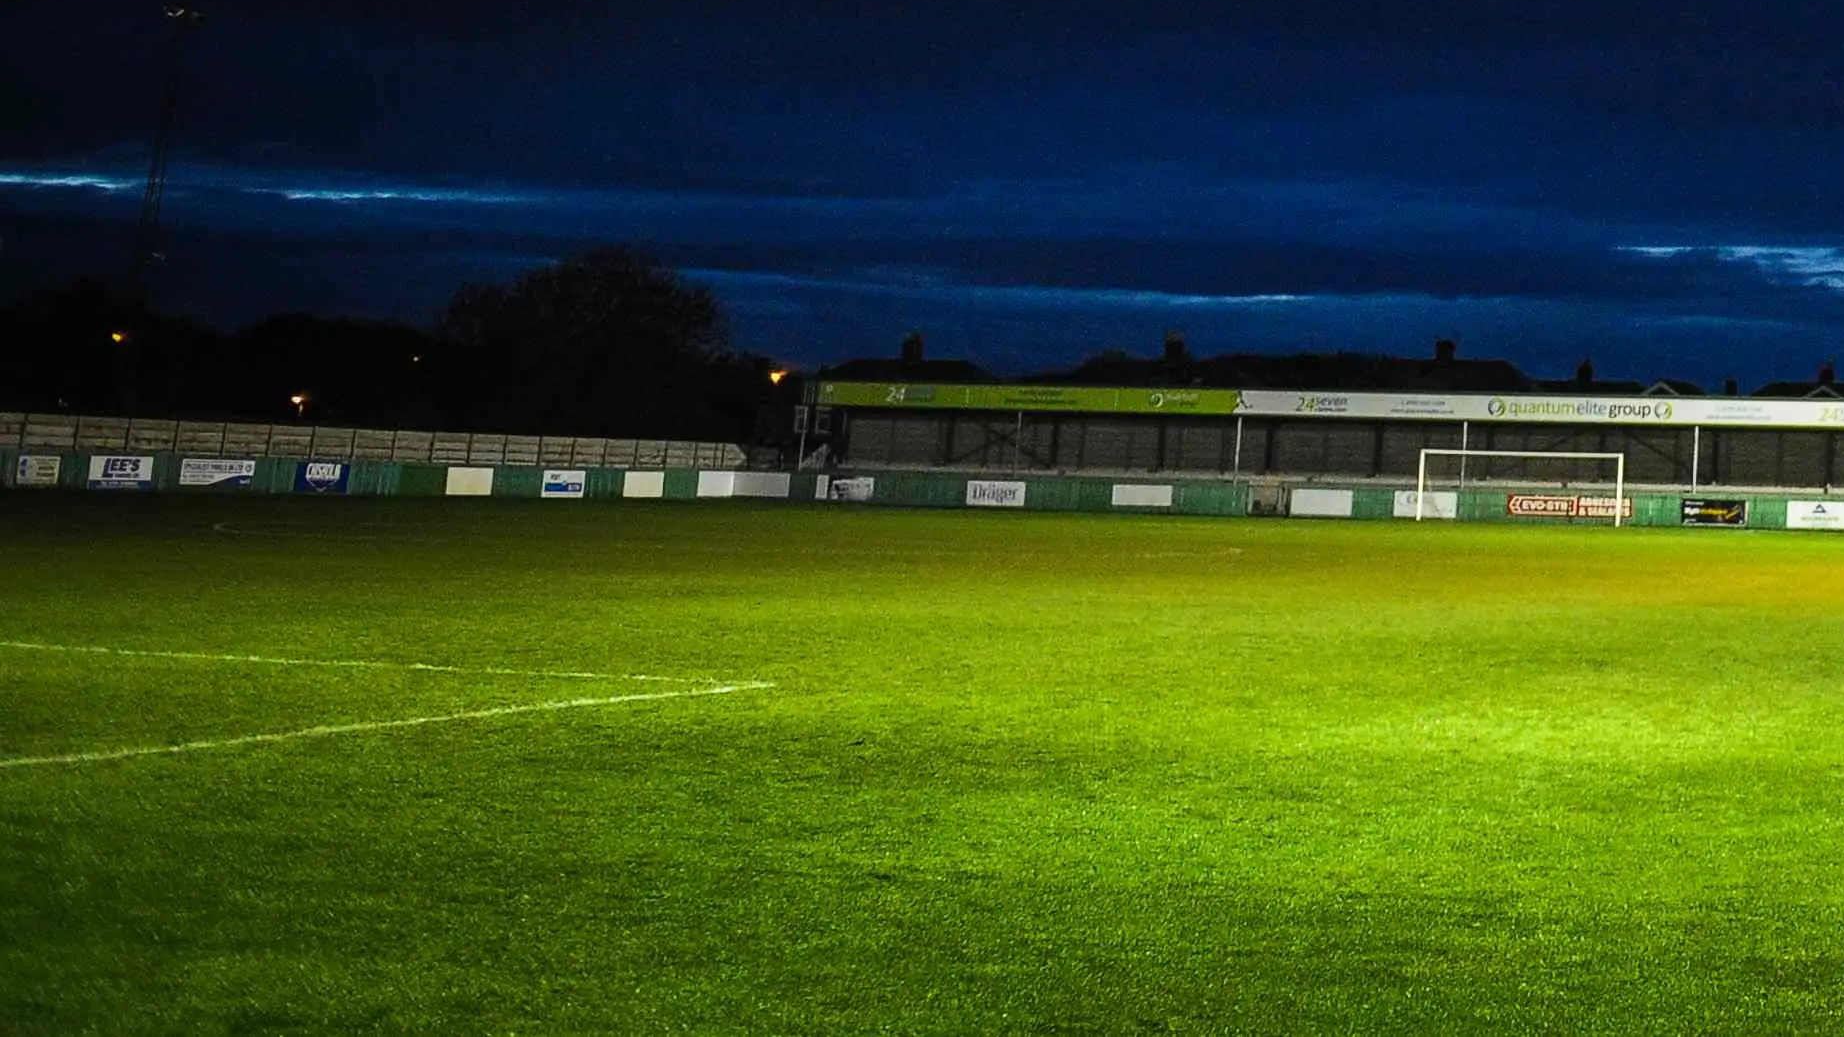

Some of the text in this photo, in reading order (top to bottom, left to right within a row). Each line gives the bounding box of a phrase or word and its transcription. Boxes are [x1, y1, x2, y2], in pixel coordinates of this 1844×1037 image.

[1508, 401, 1650, 420] quantum elite group
[102, 458, 140, 478] LEE'S
